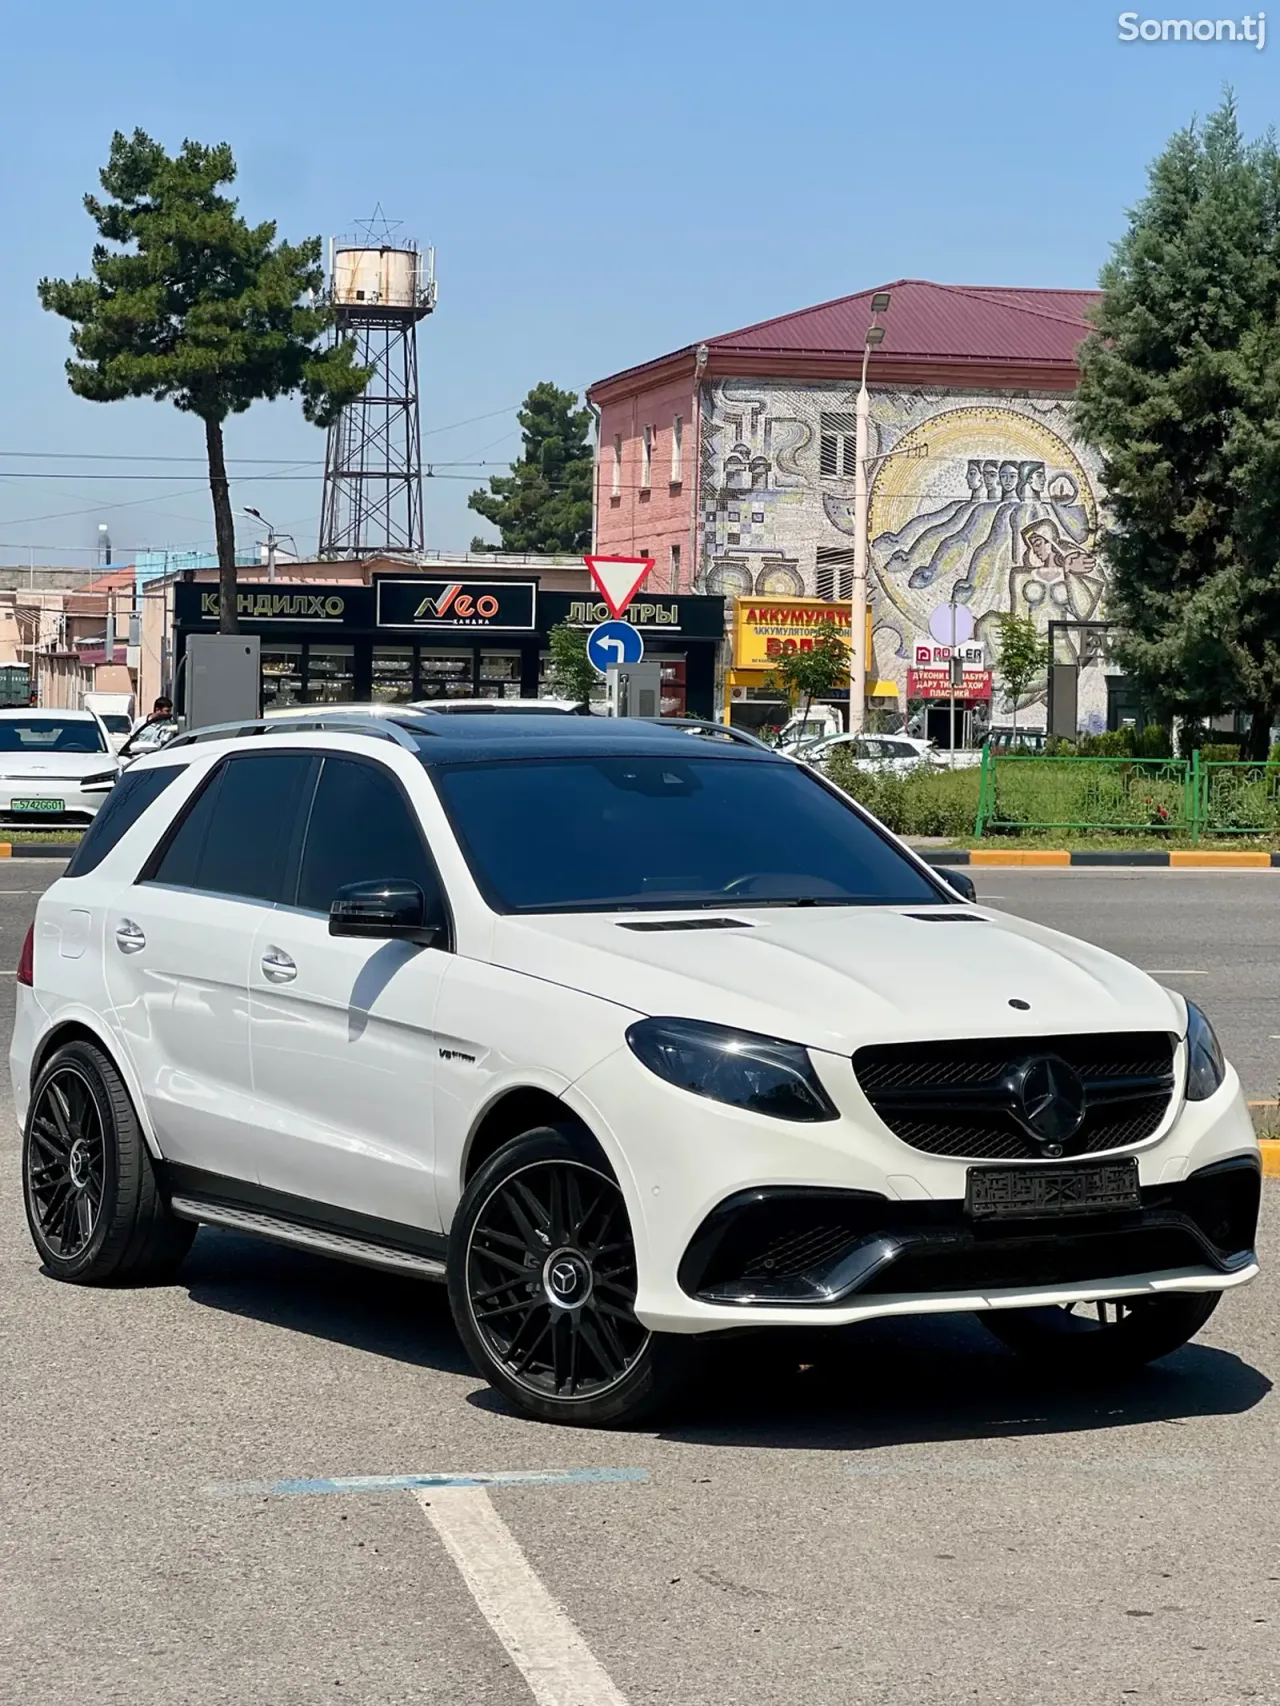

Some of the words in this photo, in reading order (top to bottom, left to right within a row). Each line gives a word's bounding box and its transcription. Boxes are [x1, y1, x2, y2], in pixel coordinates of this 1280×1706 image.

[201, 593, 345, 618] ҚНДИЛҲО
[567, 602, 678, 624] ЛЮТРЫ
[933, 647, 982, 660] ROLER
